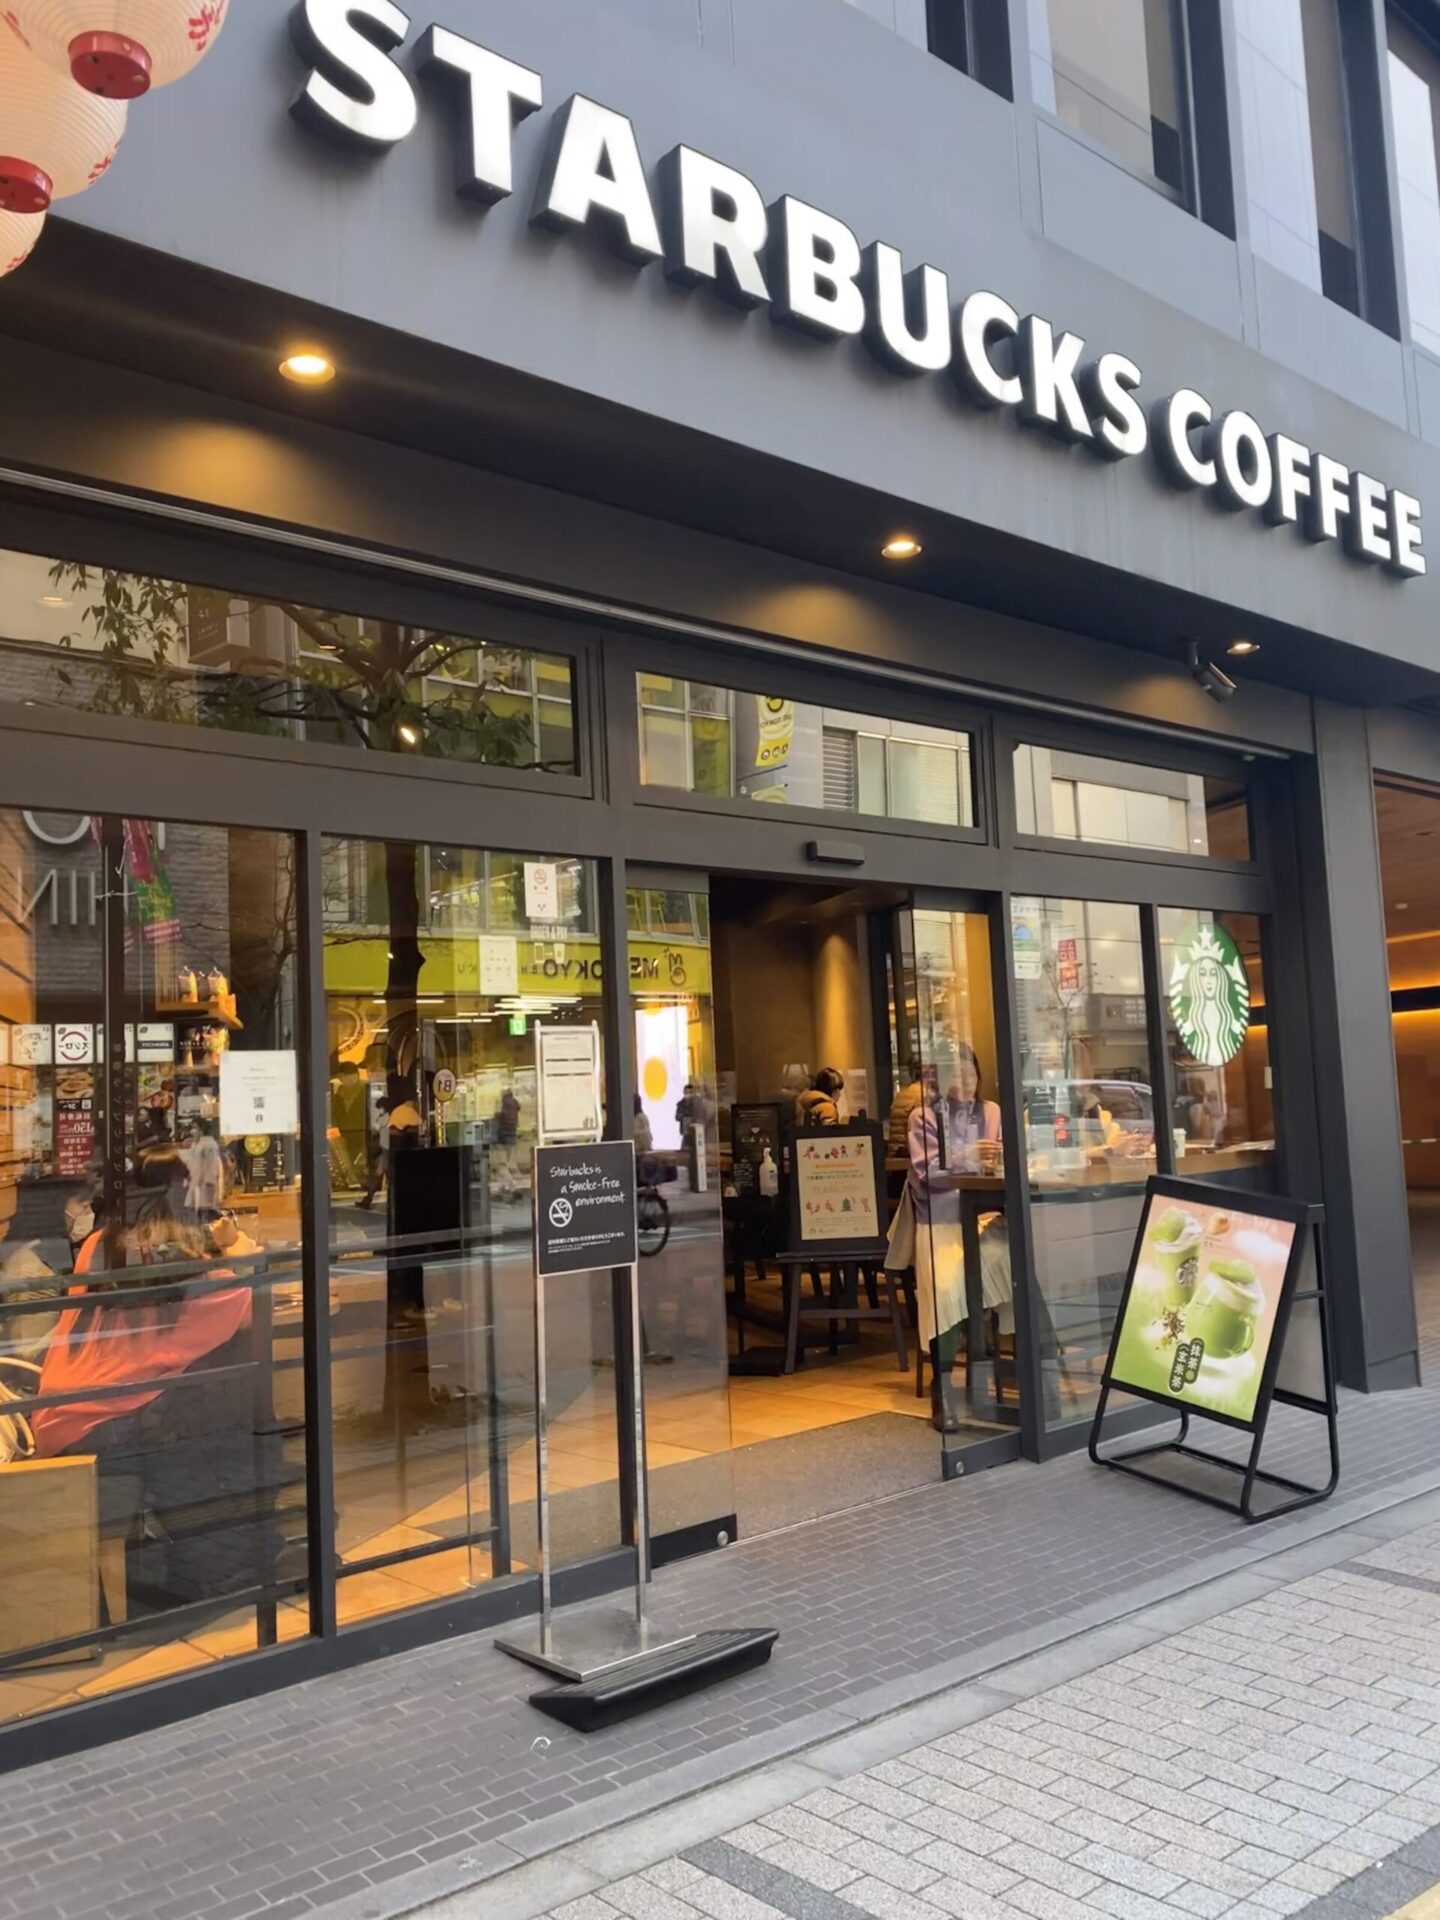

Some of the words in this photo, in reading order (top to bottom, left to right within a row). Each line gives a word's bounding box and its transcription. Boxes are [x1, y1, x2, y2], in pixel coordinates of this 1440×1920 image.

[300, 0, 1149, 459] STARBUCKS
[1164, 386, 1428, 578] COFFEE
[549, 1162, 594, 1178] Starbucks
[594, 1163, 602, 1175] is
[560, 1184, 568, 1194] a
[575, 1191, 626, 1207] environment
[1171, 1350, 1189, 1389] 玄米茶
